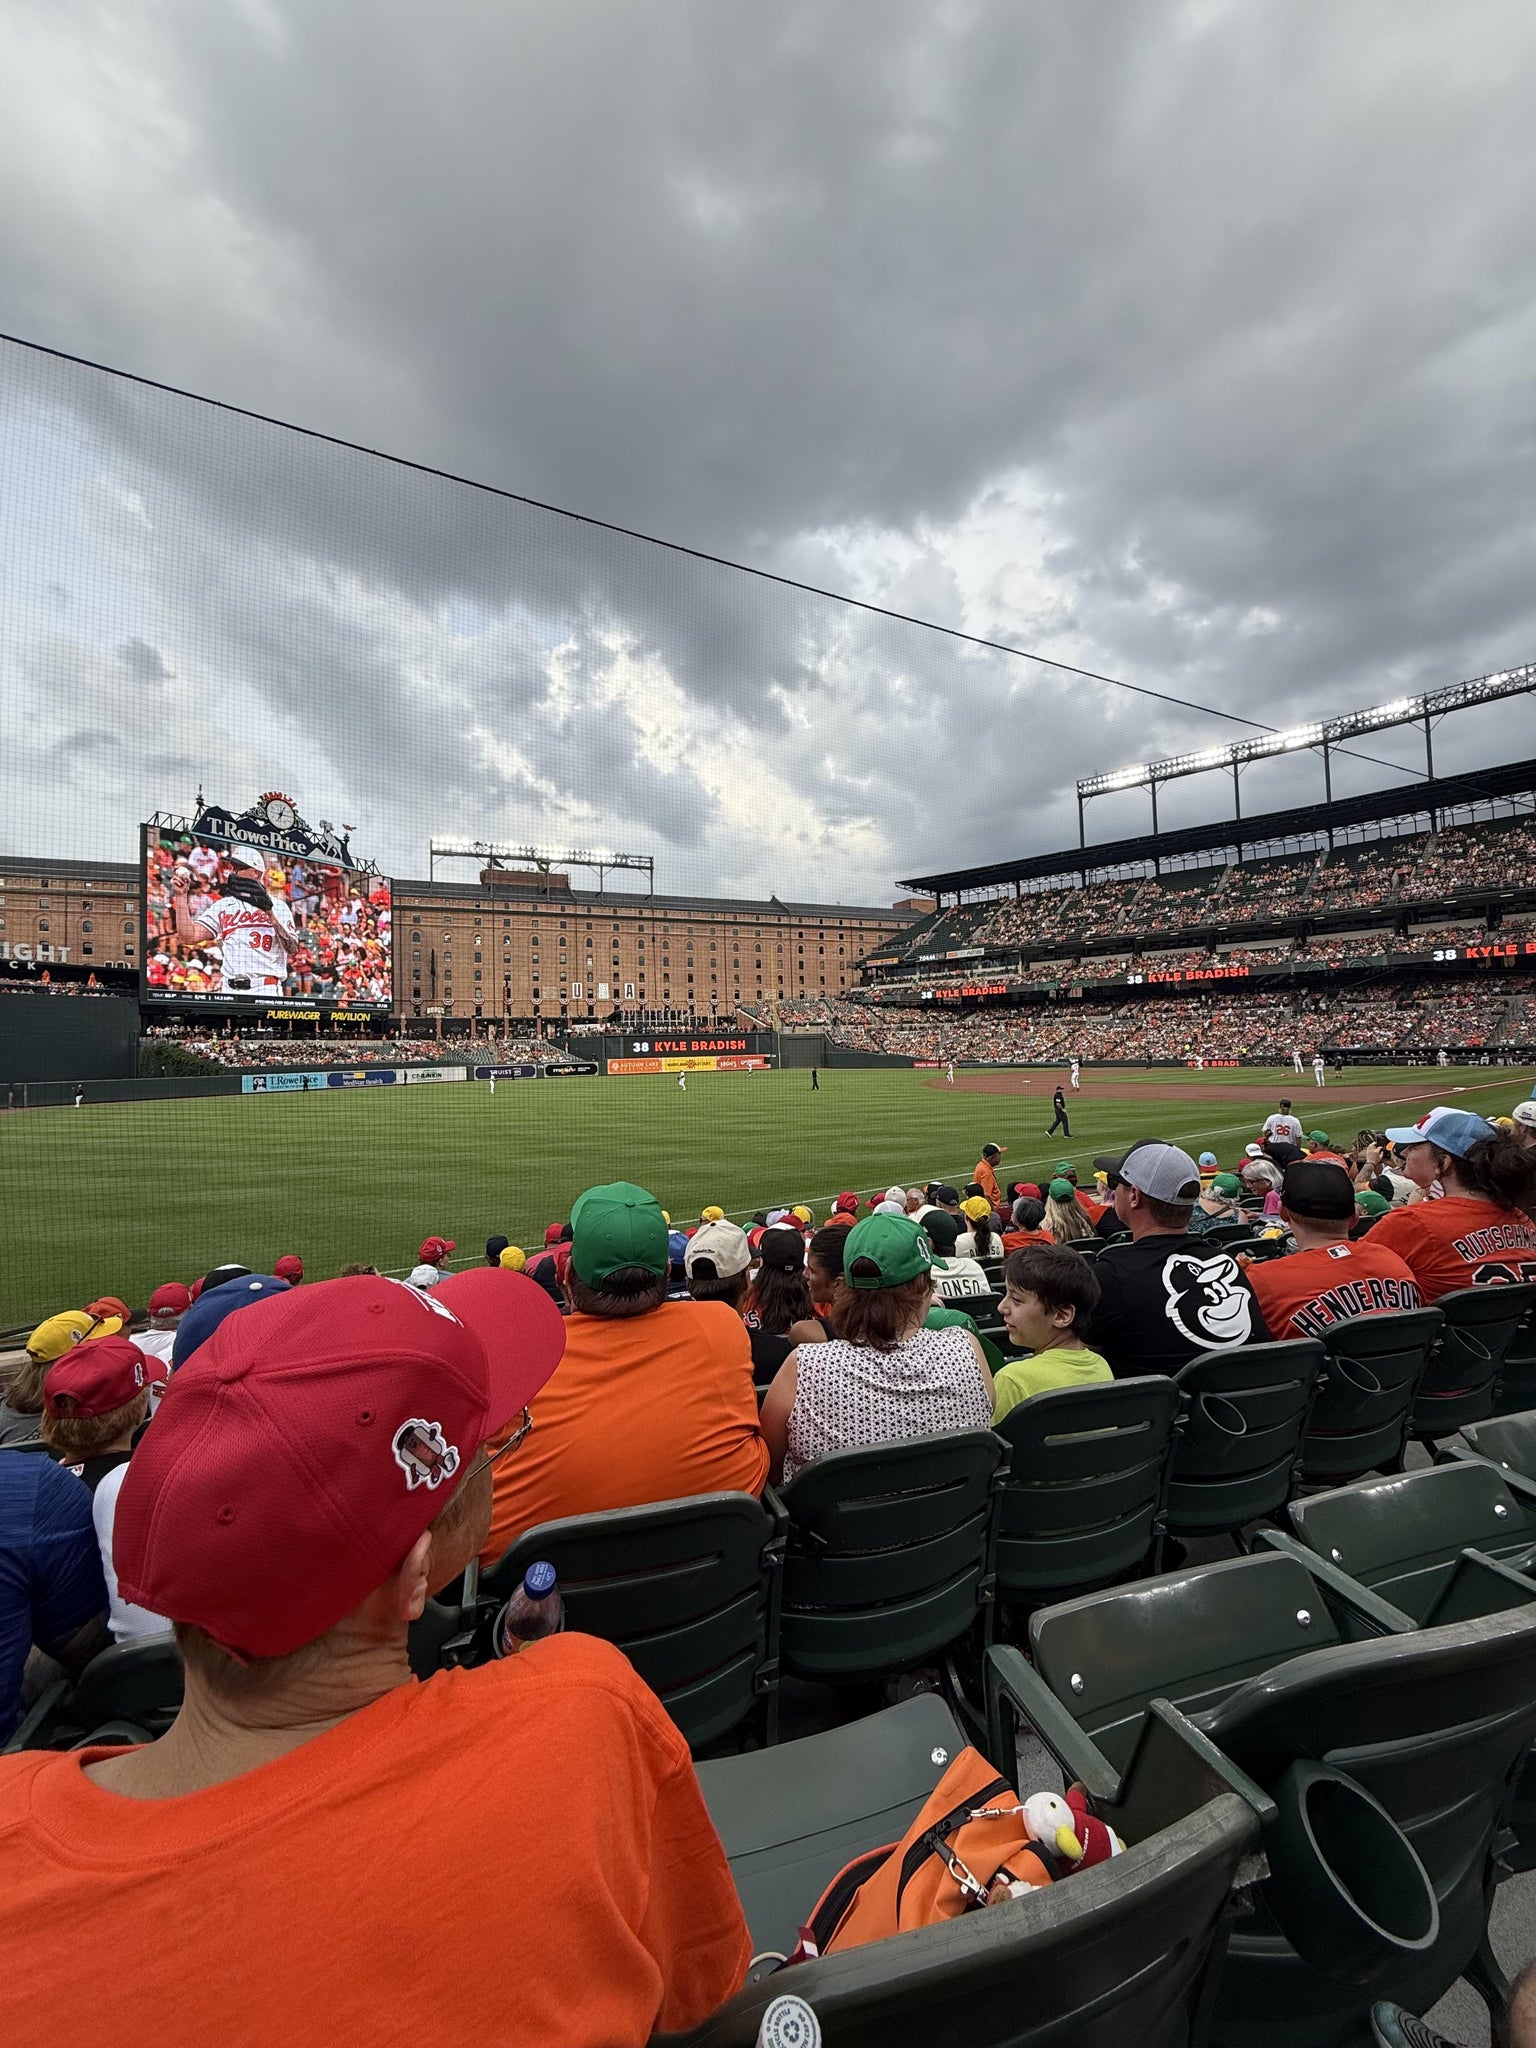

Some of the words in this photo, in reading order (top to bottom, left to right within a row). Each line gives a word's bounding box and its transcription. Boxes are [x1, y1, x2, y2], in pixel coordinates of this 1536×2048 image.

[249, 931, 272, 952] 38
[1433, 949, 1457, 961] 38
[1466, 944, 1518, 959] KYLE
[1126, 974, 1143, 984] 38
[1148, 972, 1181, 983] KYLE
[1186, 966, 1249, 980] BRADISH
[921, 991, 933, 1000] 38
[936, 988, 959, 998] KYLE
[962, 986, 1006, 997] BRADISH
[267, 1010, 320, 1020] PUREWAGER
[331, 1011, 370, 1021] PAVILION
[632, 1042, 649, 1053] 38
[654, 1041, 687, 1052] KYLE
[691, 1040, 746, 1050] BRADISH
[1275, 1124, 1291, 1136] 26
[1290, 1277, 1422, 1338] HENDERSON
[774, 2008, 791, 2026] BOTTLE
